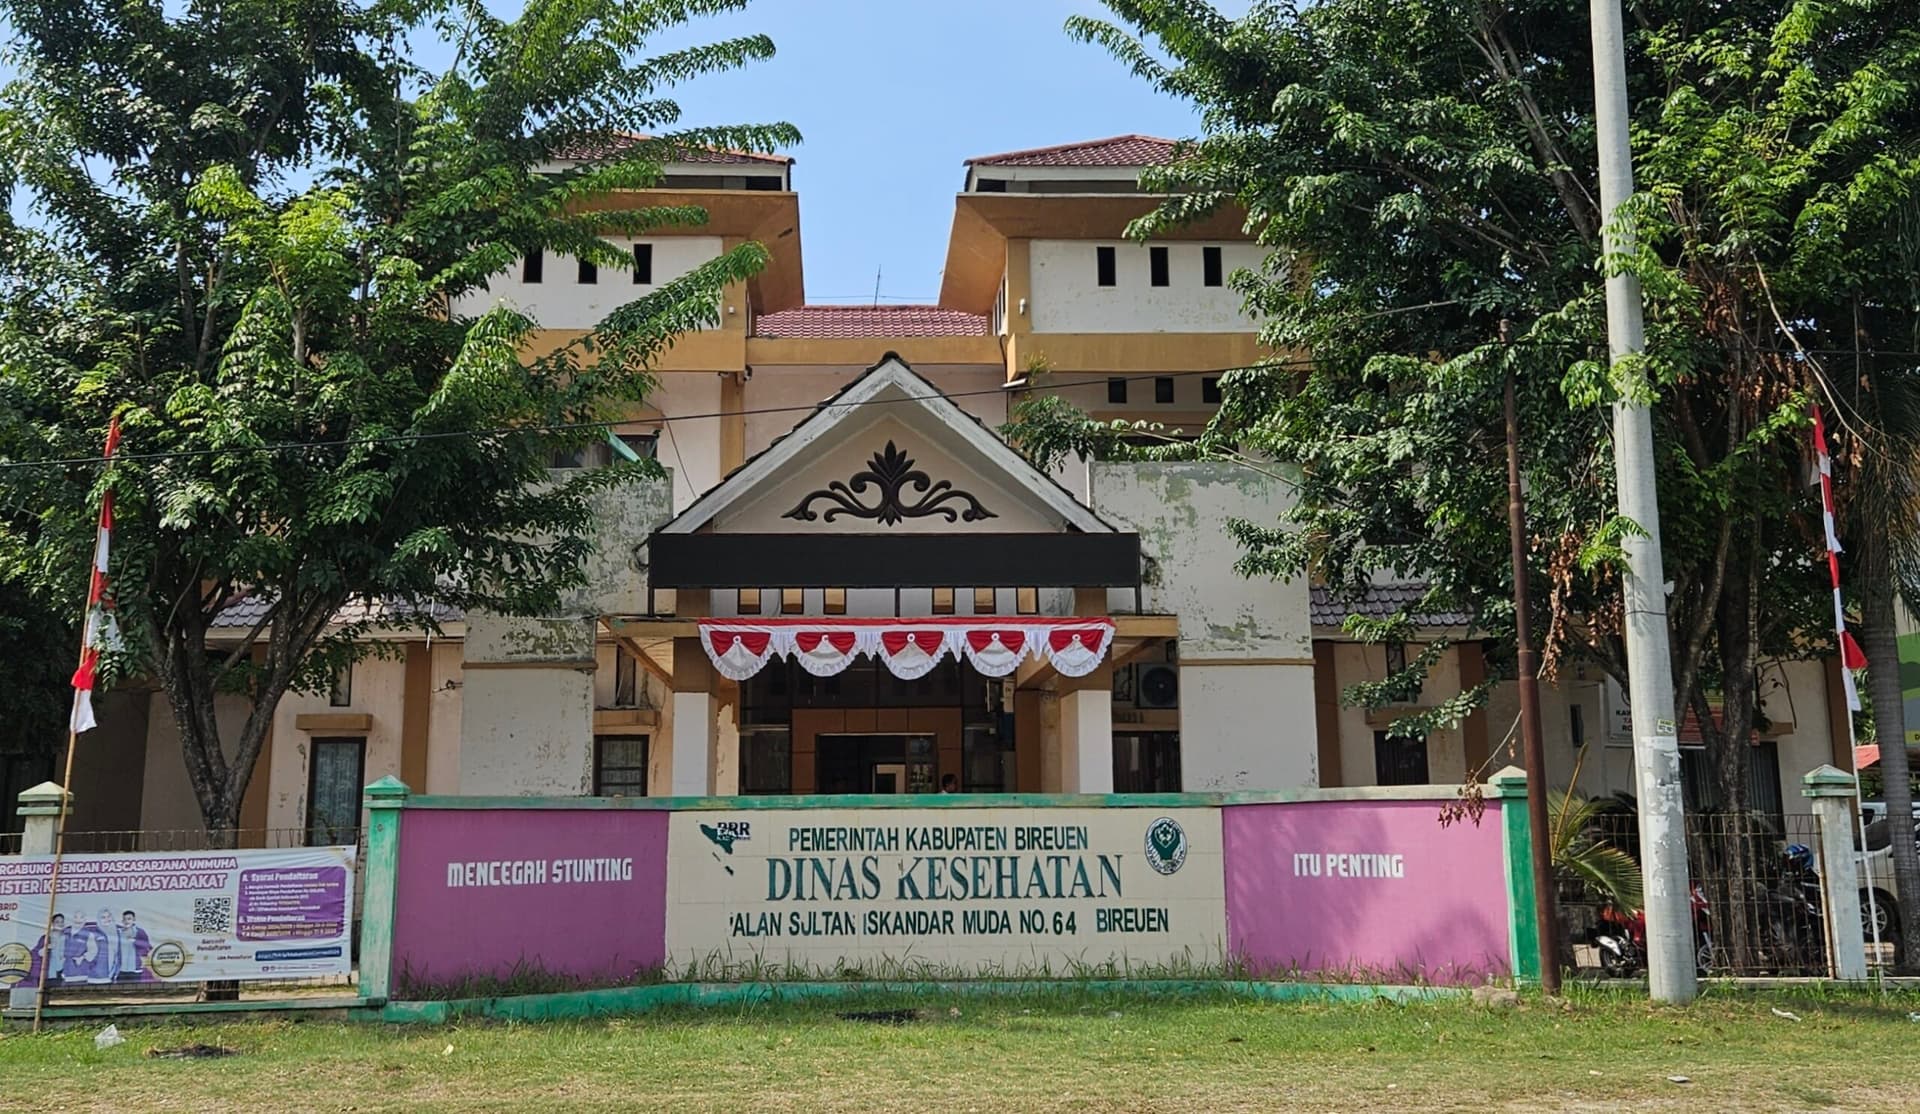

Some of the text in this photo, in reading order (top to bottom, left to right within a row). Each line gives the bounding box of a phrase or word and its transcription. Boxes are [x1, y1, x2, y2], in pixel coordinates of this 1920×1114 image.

[789, 825, 1088, 851] PEMERINTAH KABUPATEN BIREUEN
[101, 859, 186, 873] PASCASARJANA
[188, 857, 238, 870] UNMUHA
[447, 858, 632, 887] MENCEGAH STUNTING
[766, 854, 1123, 901] DINAS KESEHATAN
[1294, 854, 1404, 878] ITU PENTING
[42, 876, 128, 894] KESEHATAN
[129, 873, 228, 891] MASYARAKAT
[730, 908, 1168, 937] ALAN SULTAN ISKANDAR MUDA NO. 64 BIREUEN
